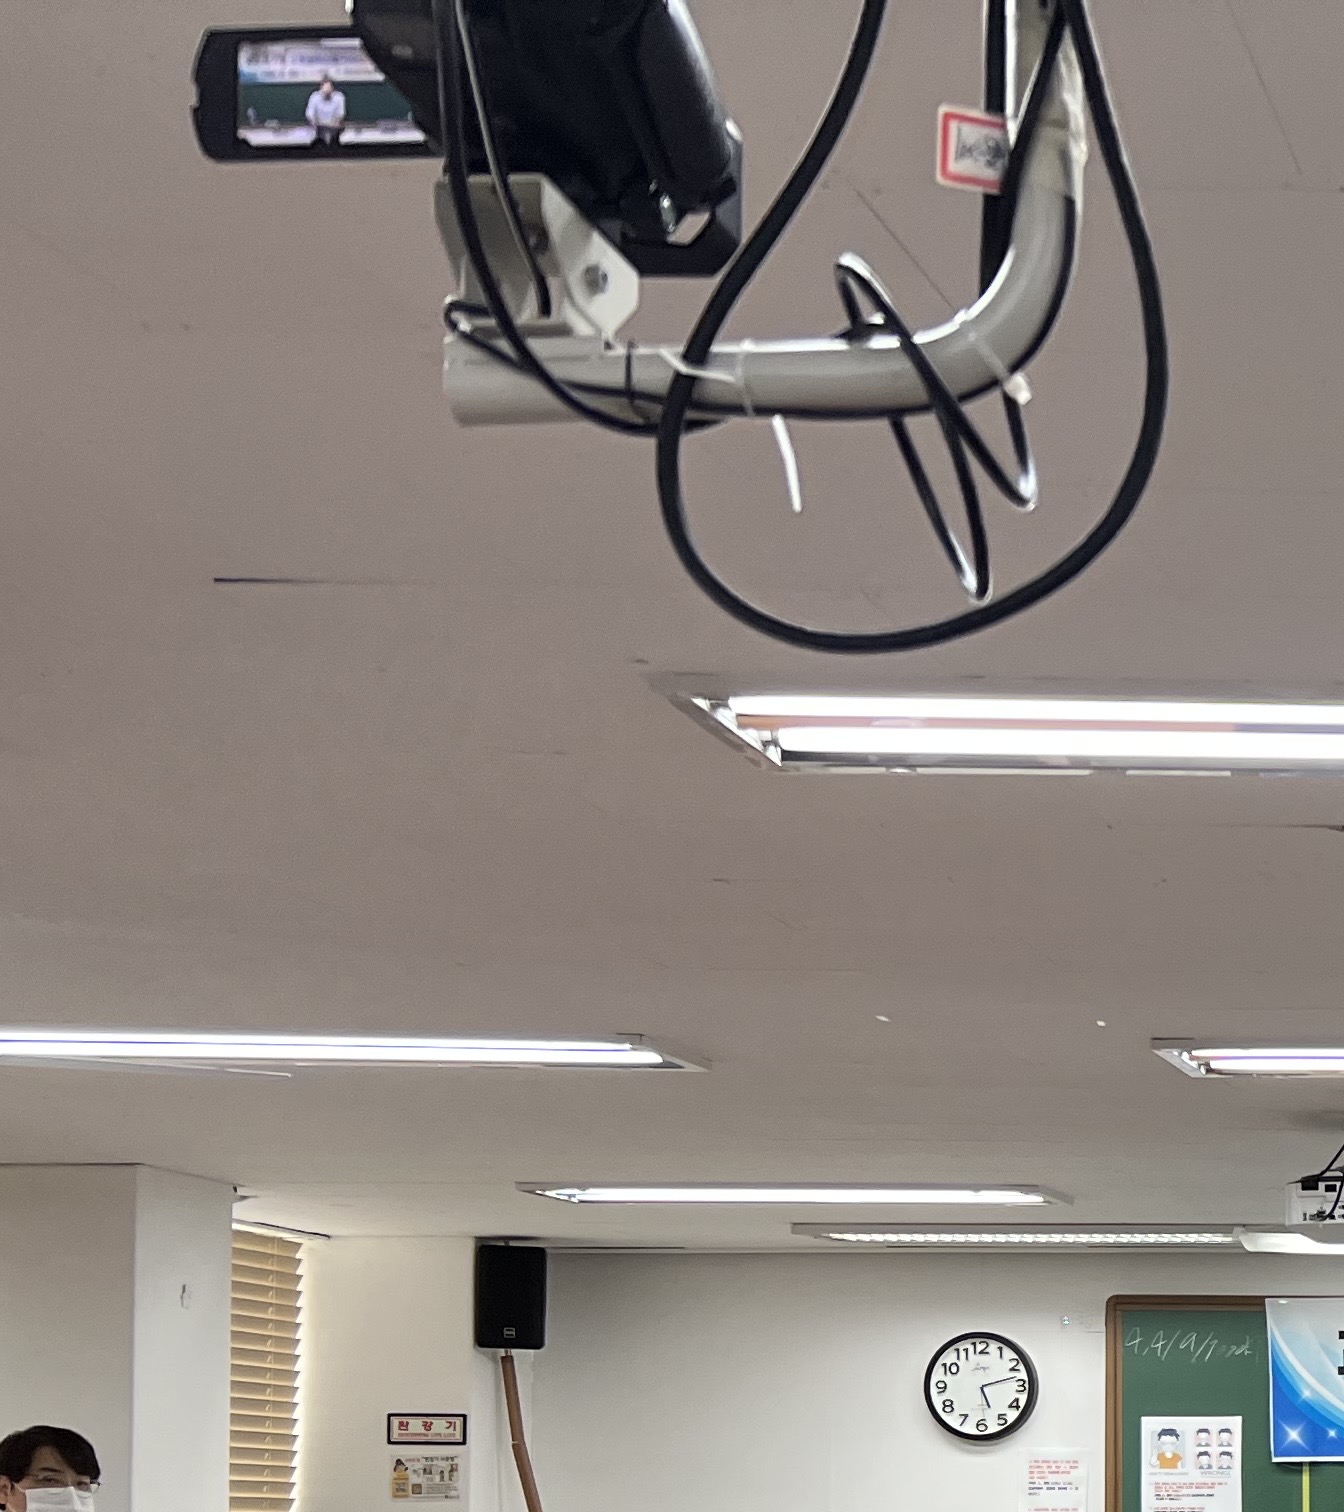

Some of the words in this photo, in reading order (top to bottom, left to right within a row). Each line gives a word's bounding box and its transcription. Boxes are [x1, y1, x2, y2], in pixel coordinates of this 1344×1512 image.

[954, 1347, 969, 1361] 11
[971, 1341, 990, 1355] 12
[997, 1346, 1003, 1359] 1
[941, 1362, 960, 1376] 10
[1009, 1358, 1020, 1372] 2
[935, 1380, 948, 1394] 9
[1015, 1379, 1027, 1393] 3
[941, 1398, 955, 1414] 8
[1007, 1397, 1021, 1411] 4
[958, 1413, 969, 1427] 7
[976, 1418, 989, 1433] 6
[997, 1413, 1008, 1427] 5
